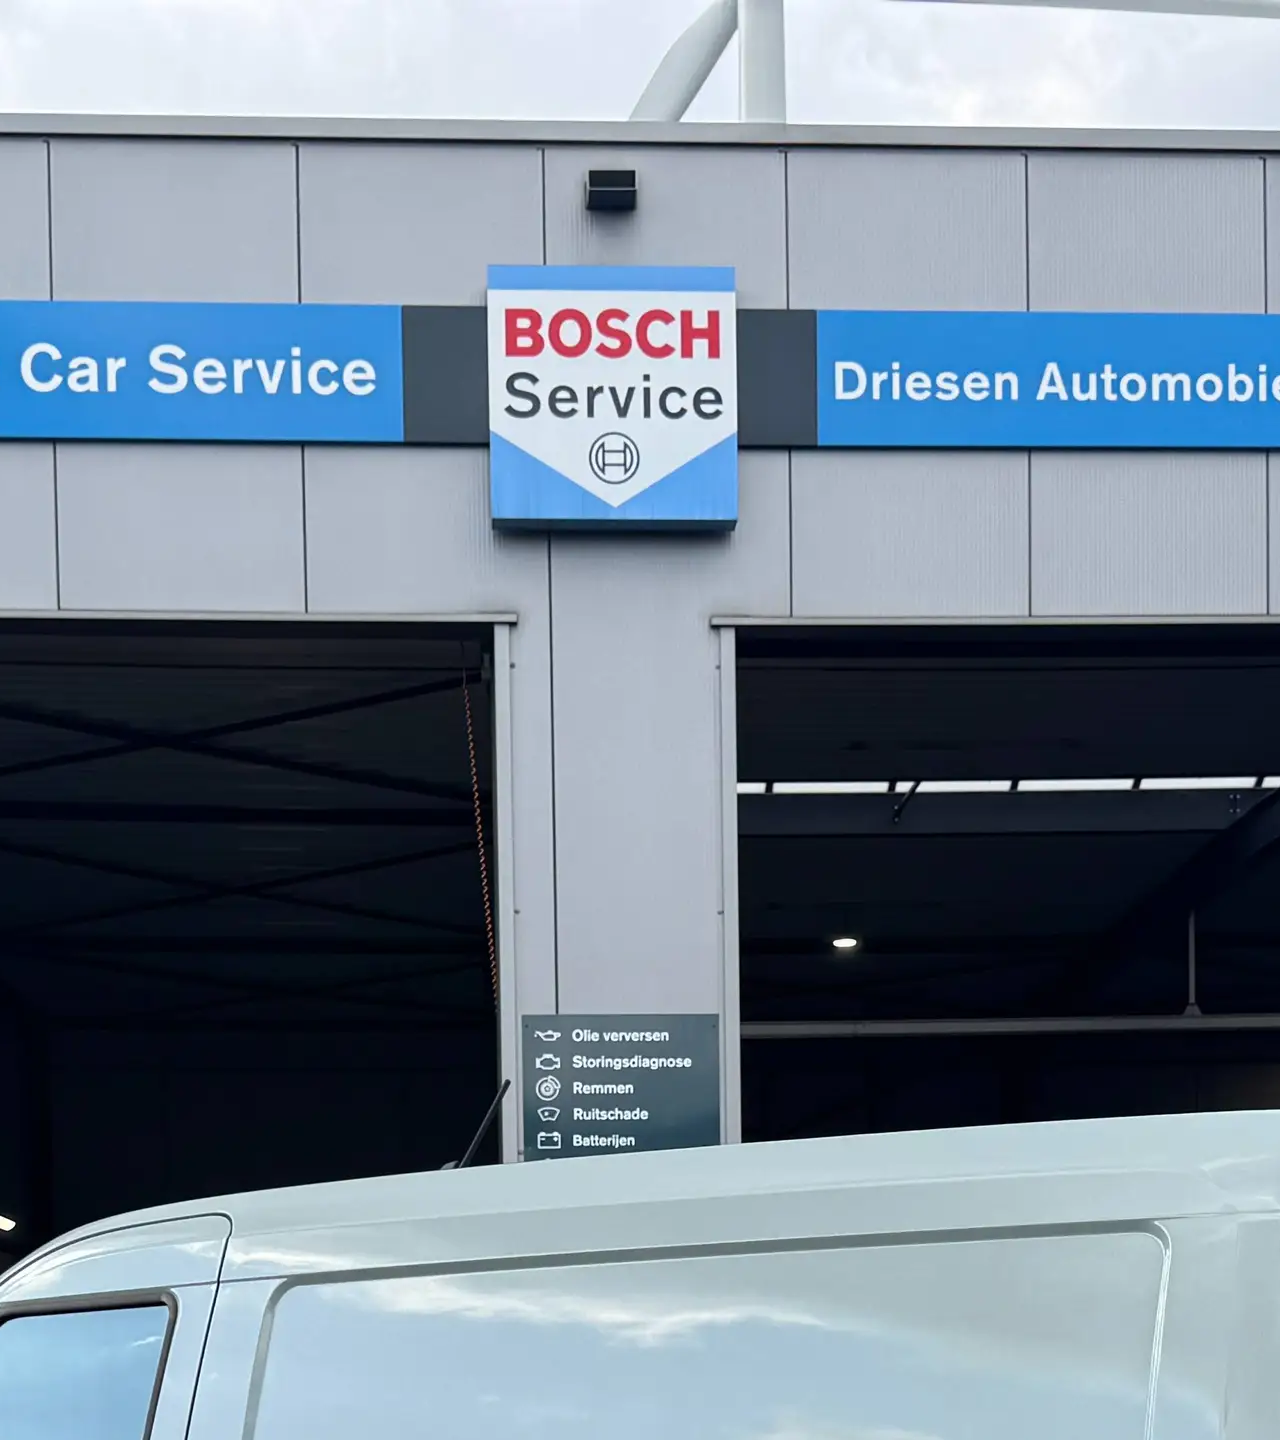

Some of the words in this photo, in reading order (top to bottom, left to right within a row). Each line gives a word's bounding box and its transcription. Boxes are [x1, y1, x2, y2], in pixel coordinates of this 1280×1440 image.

[504, 308, 720, 359] BOSCH
[21, 342, 126, 394] Car
[147, 345, 377, 396] Service
[834, 360, 1019, 401] Driesen
[504, 371, 724, 420] Service
[572, 1029, 600, 1042] Olie
[603, 1032, 670, 1042] verversen
[572, 1055, 692, 1070] Storingsdiagnose
[573, 1082, 634, 1095] Remmen
[573, 1108, 649, 1121] Ruitschade
[572, 1134, 636, 1149] Batterijen
